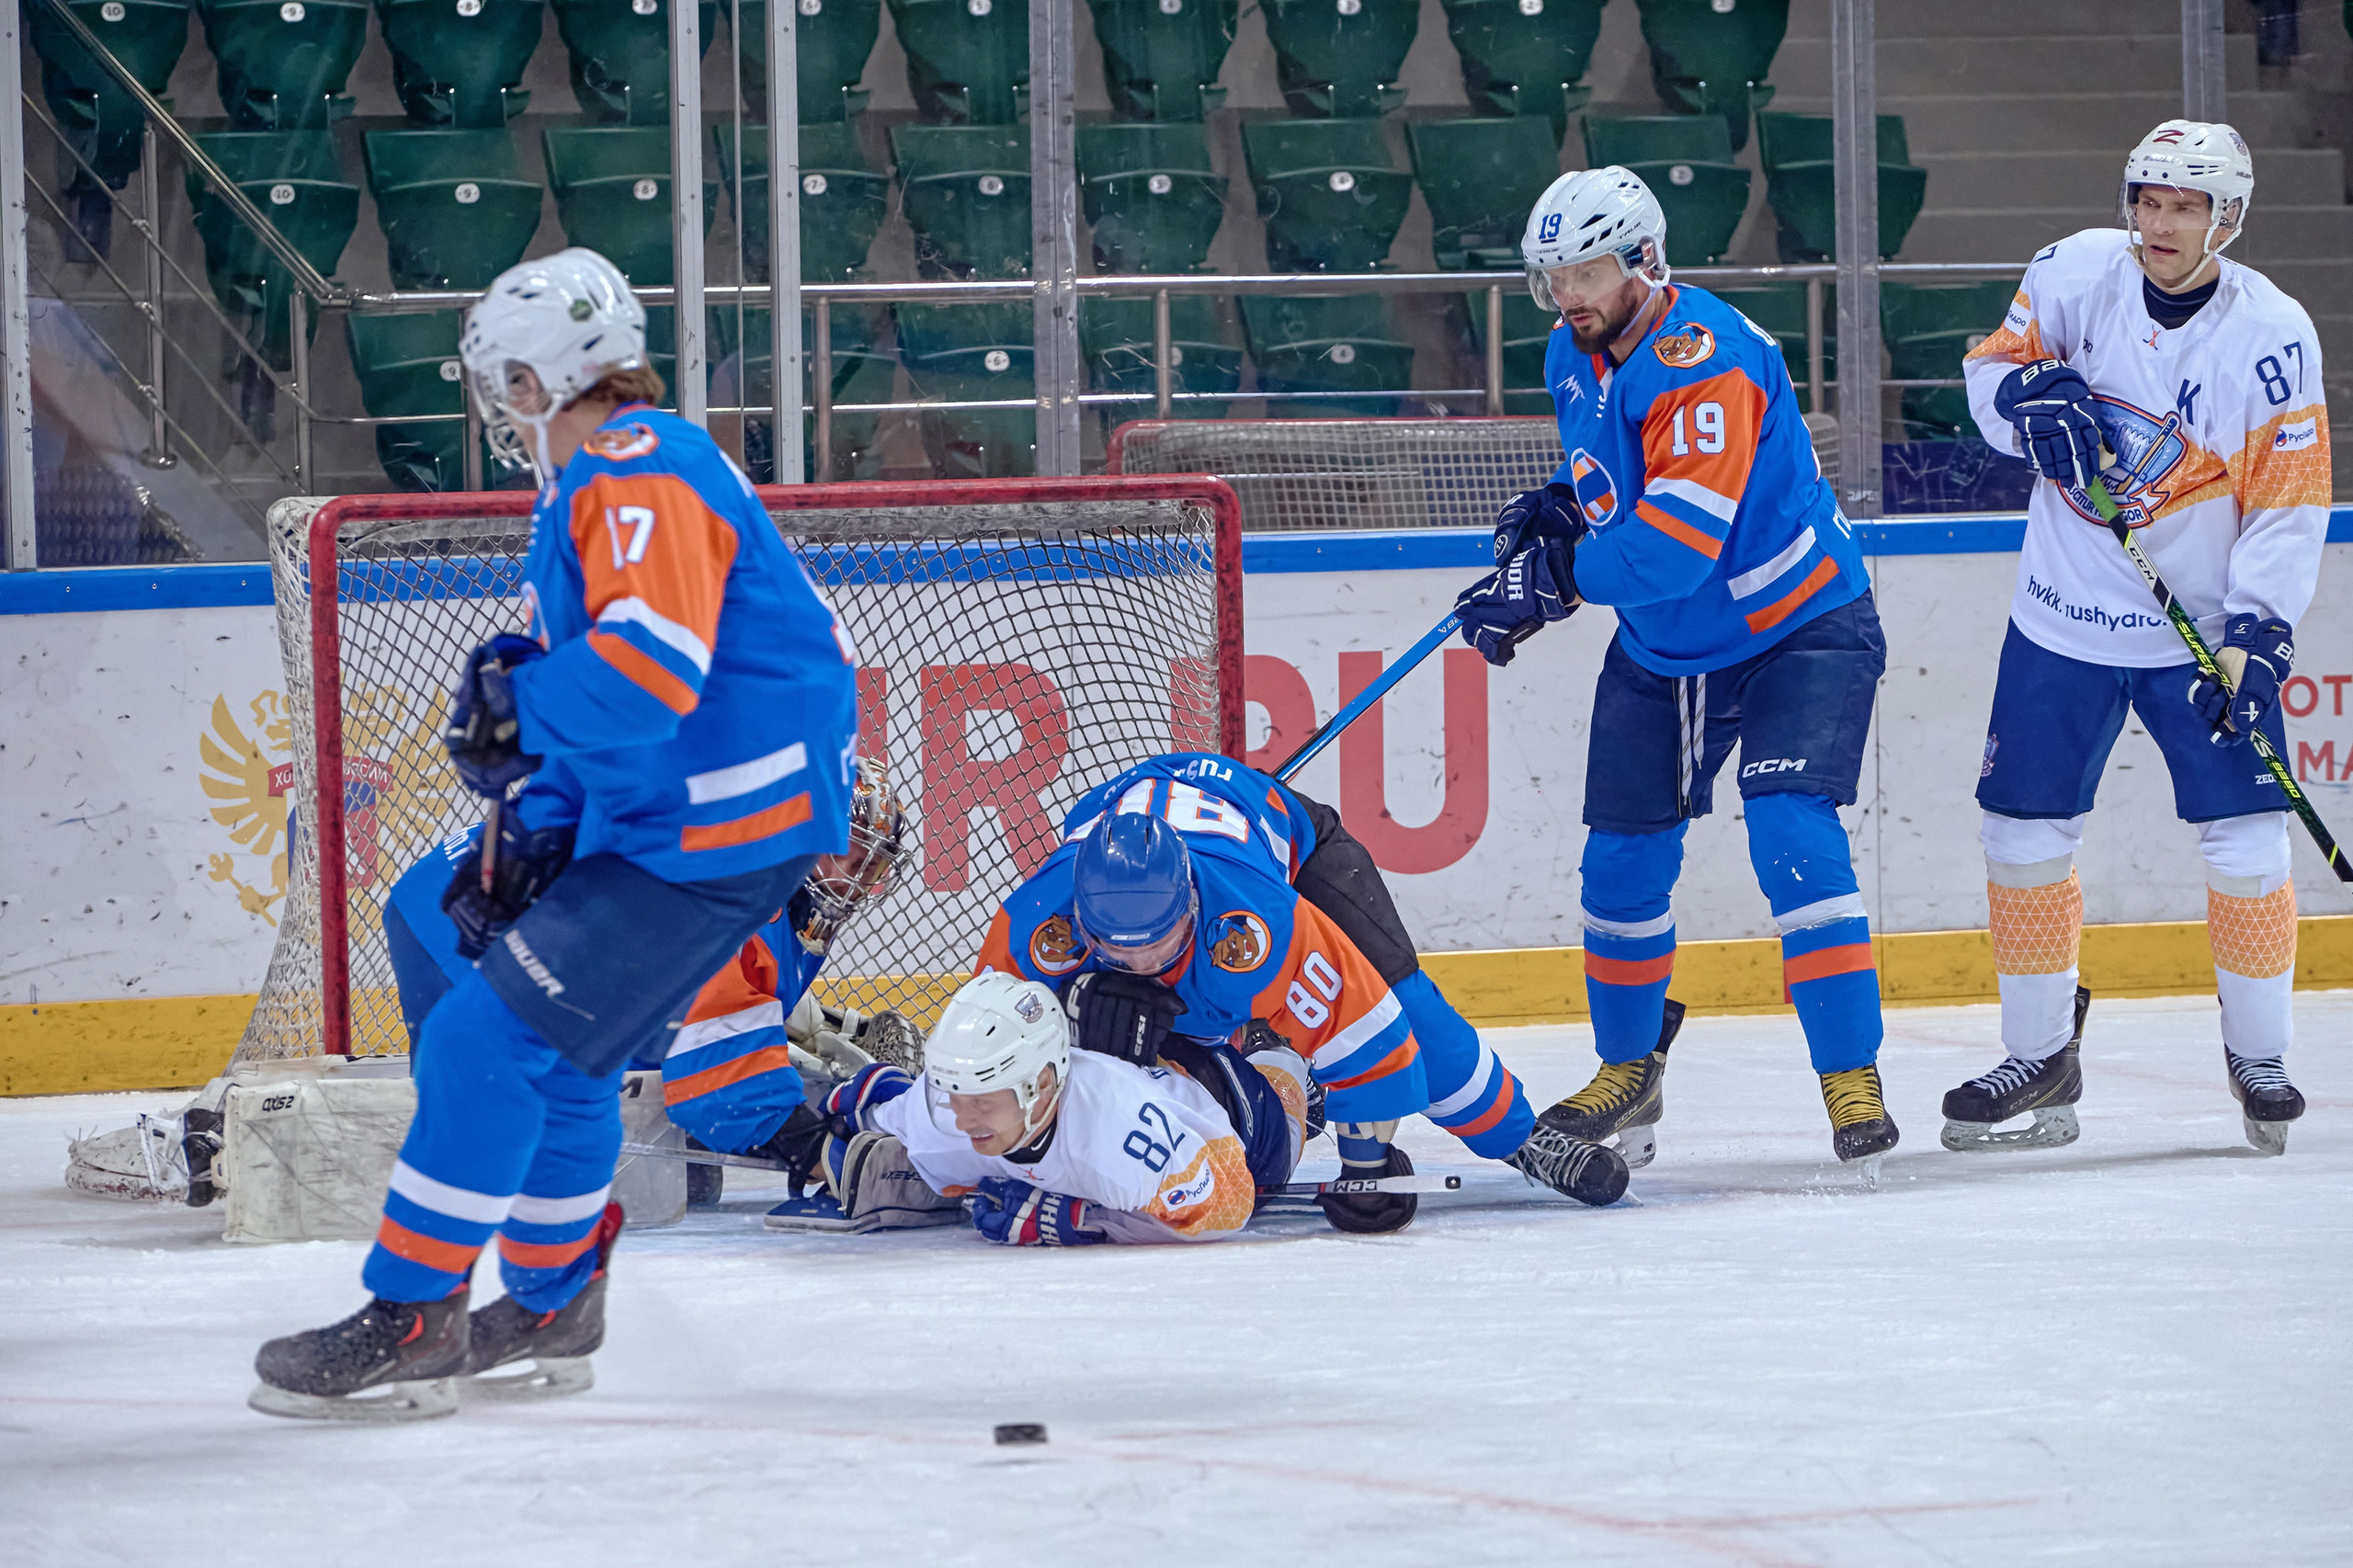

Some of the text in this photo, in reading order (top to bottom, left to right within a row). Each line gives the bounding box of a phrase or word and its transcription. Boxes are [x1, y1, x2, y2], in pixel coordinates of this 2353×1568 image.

[1538, 212, 1563, 240] 19
[1617, 221, 1642, 240] TRUE
[2255, 341, 2303, 406] 87
[1671, 401, 1725, 457] 19
[604, 505, 655, 571] 17
[2128, 546, 2155, 581] CCM
[2177, 622, 2217, 676] SUPER
[1742, 758, 1808, 778] CCM
[1285, 949, 1343, 1029] 80
[1133, 1014, 1147, 1057] EFSI
[1614, 1105, 1638, 1128] CCM
[2009, 1090, 2039, 1111] CCM
[1122, 1101, 1186, 1174] 82
[1333, 1178, 1378, 1193] CCM
